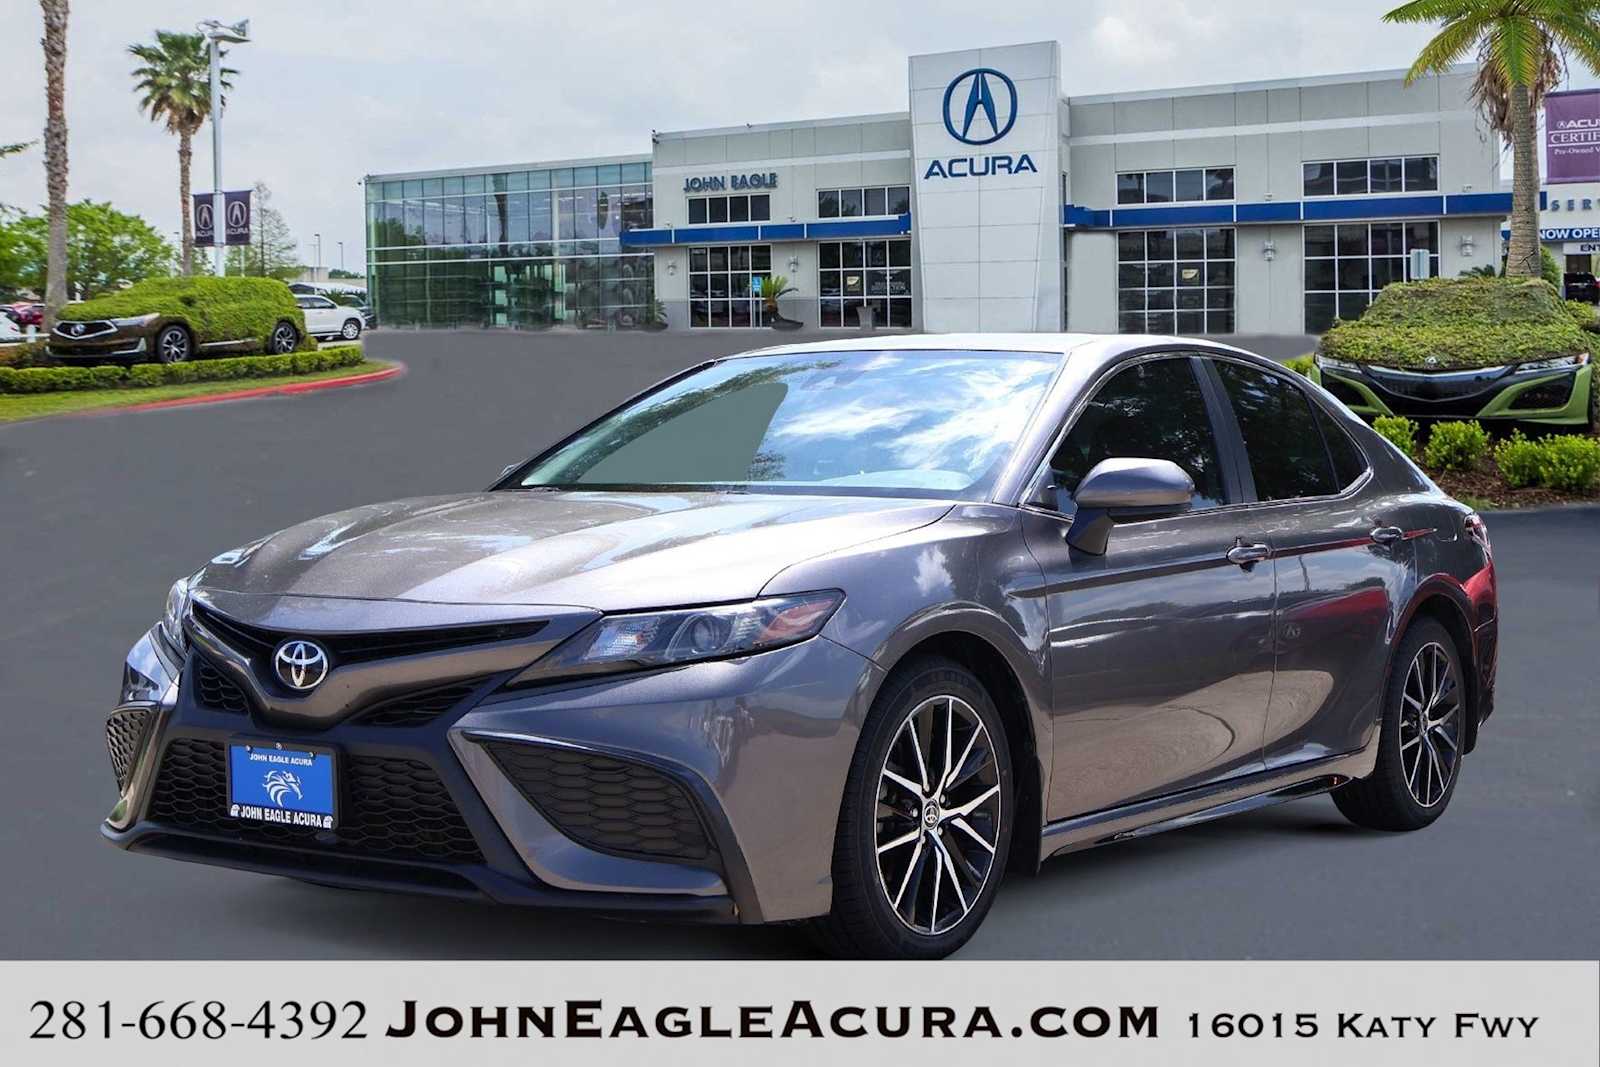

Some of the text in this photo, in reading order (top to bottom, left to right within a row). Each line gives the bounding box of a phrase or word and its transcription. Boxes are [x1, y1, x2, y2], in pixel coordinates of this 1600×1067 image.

[1554, 146, 1593, 155] Pre-Owned
[924, 154, 1038, 179] ACURA
[683, 172, 778, 192] JOHN EAGLE
[1572, 228, 1600, 238] OPE
[250, 753, 313, 766] JOHN EAGLE ACURA
[241, 806, 322, 828] JOHN EAGLE ACURA
